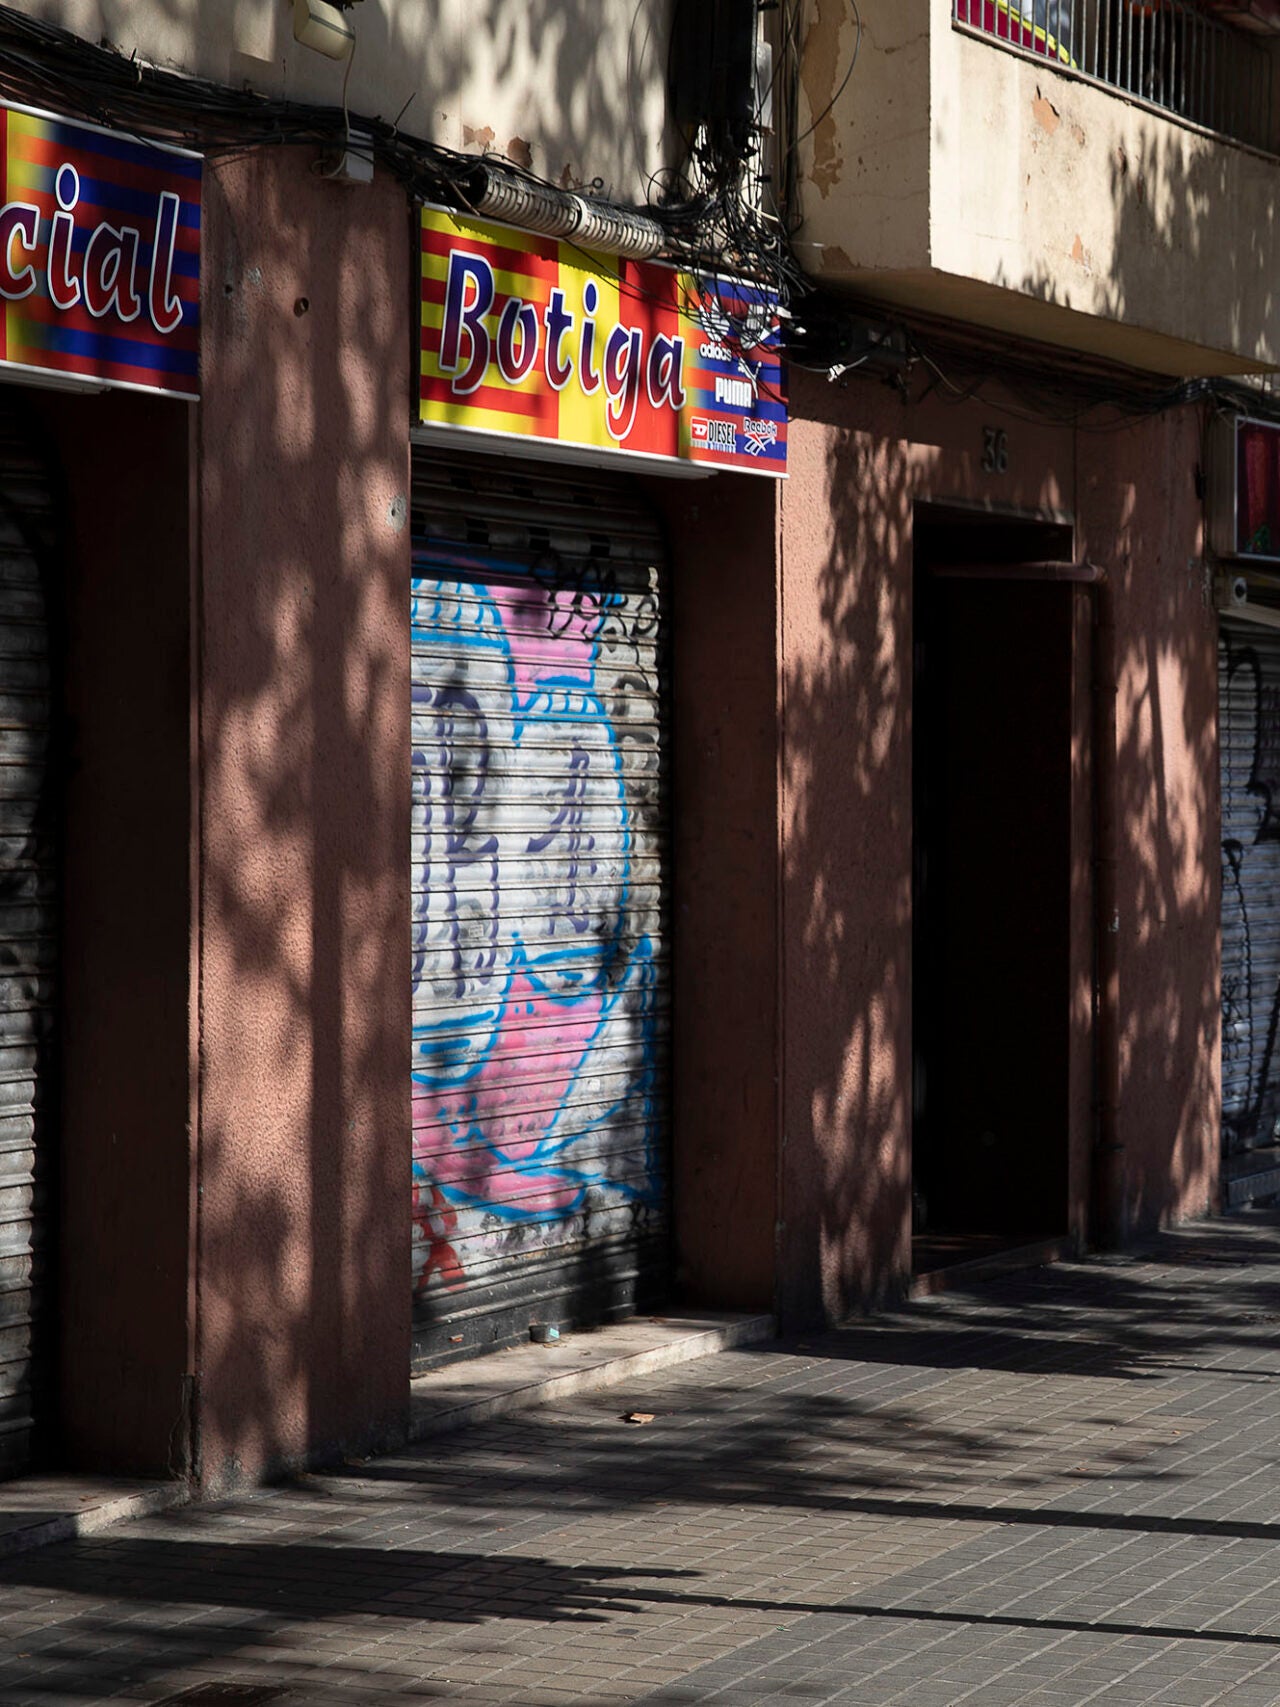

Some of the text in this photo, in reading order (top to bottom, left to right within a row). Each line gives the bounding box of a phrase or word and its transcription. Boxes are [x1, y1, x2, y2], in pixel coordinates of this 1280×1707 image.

[439, 248, 687, 441] Botiga
[700, 343, 732, 362] adidas
[715, 377, 752, 408] PUMA
[708, 420, 736, 446] DIESEL
[744, 417, 778, 437] Reebok
